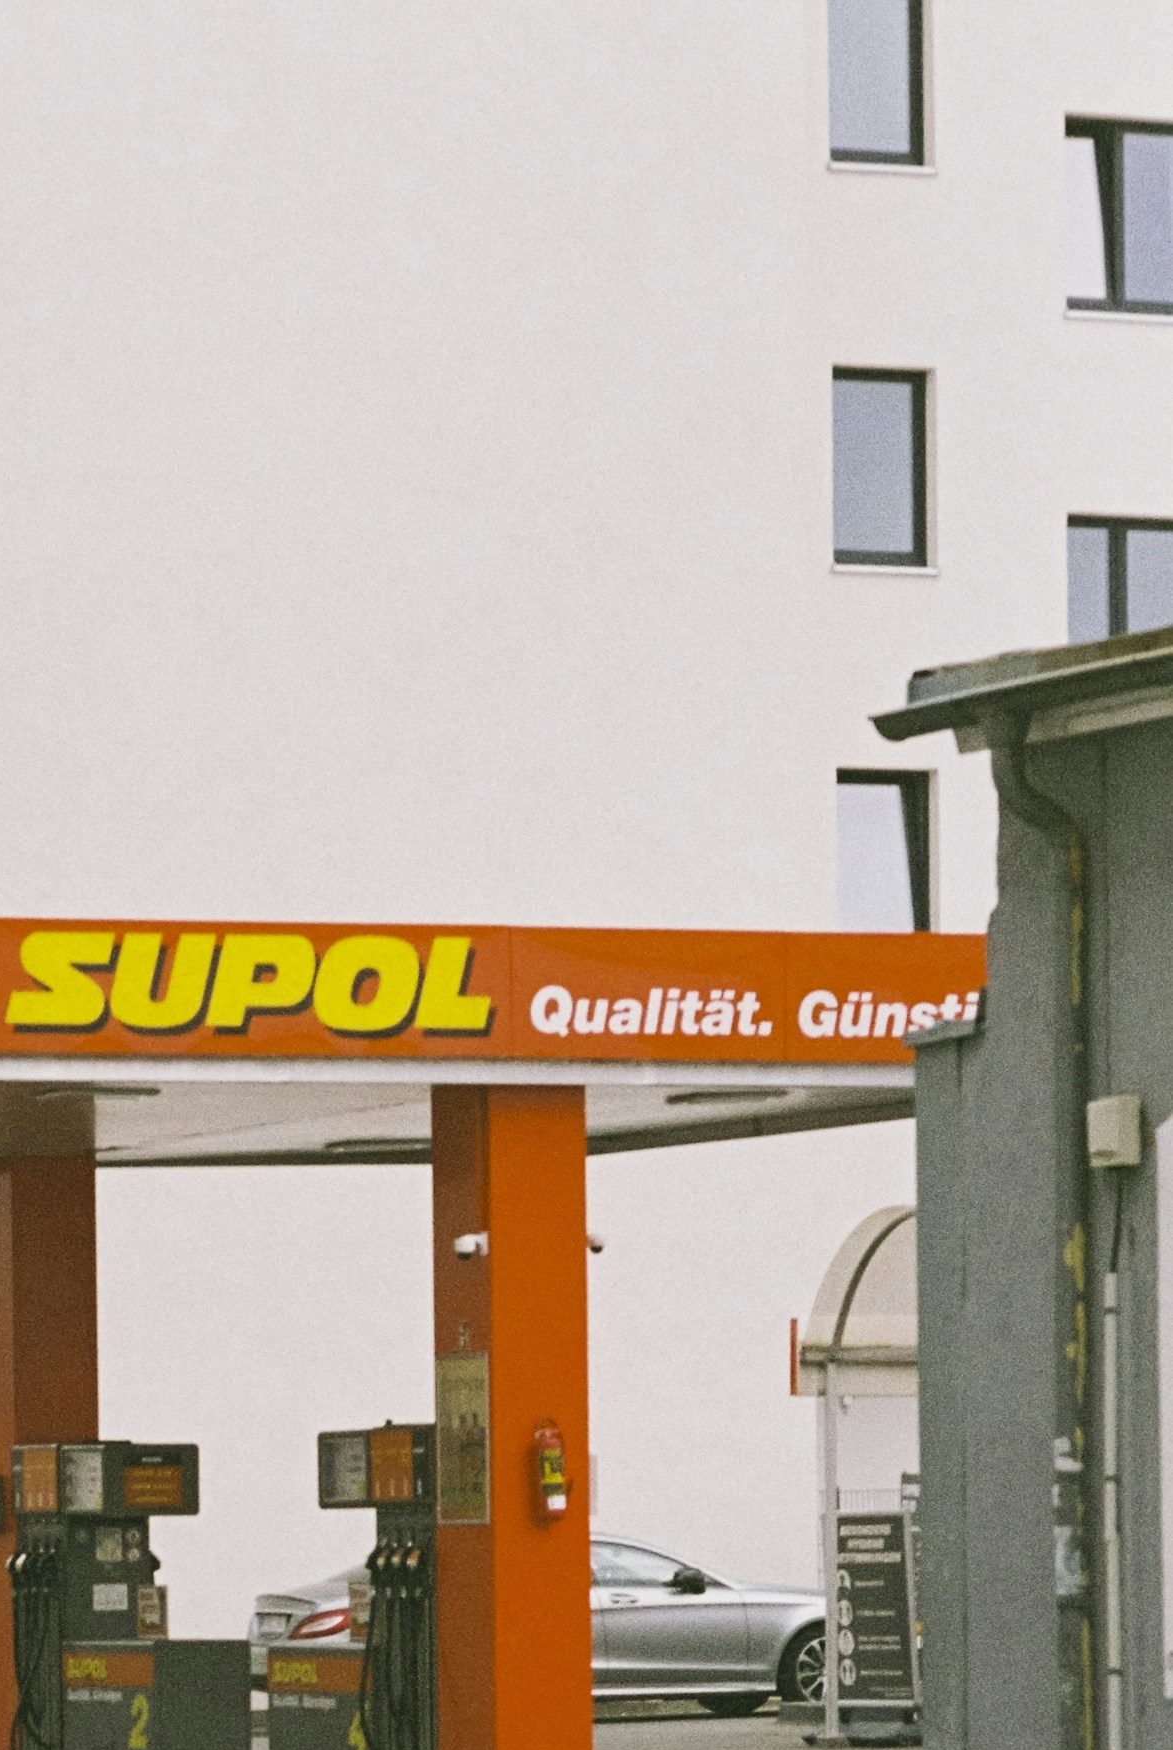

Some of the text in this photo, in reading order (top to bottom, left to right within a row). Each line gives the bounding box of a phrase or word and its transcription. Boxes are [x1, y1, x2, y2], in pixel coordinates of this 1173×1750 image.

[5, 930, 496, 1036] SUPOL
[529, 984, 774, 1038] Qualität.
[129, 1693, 150, 1750] 2
